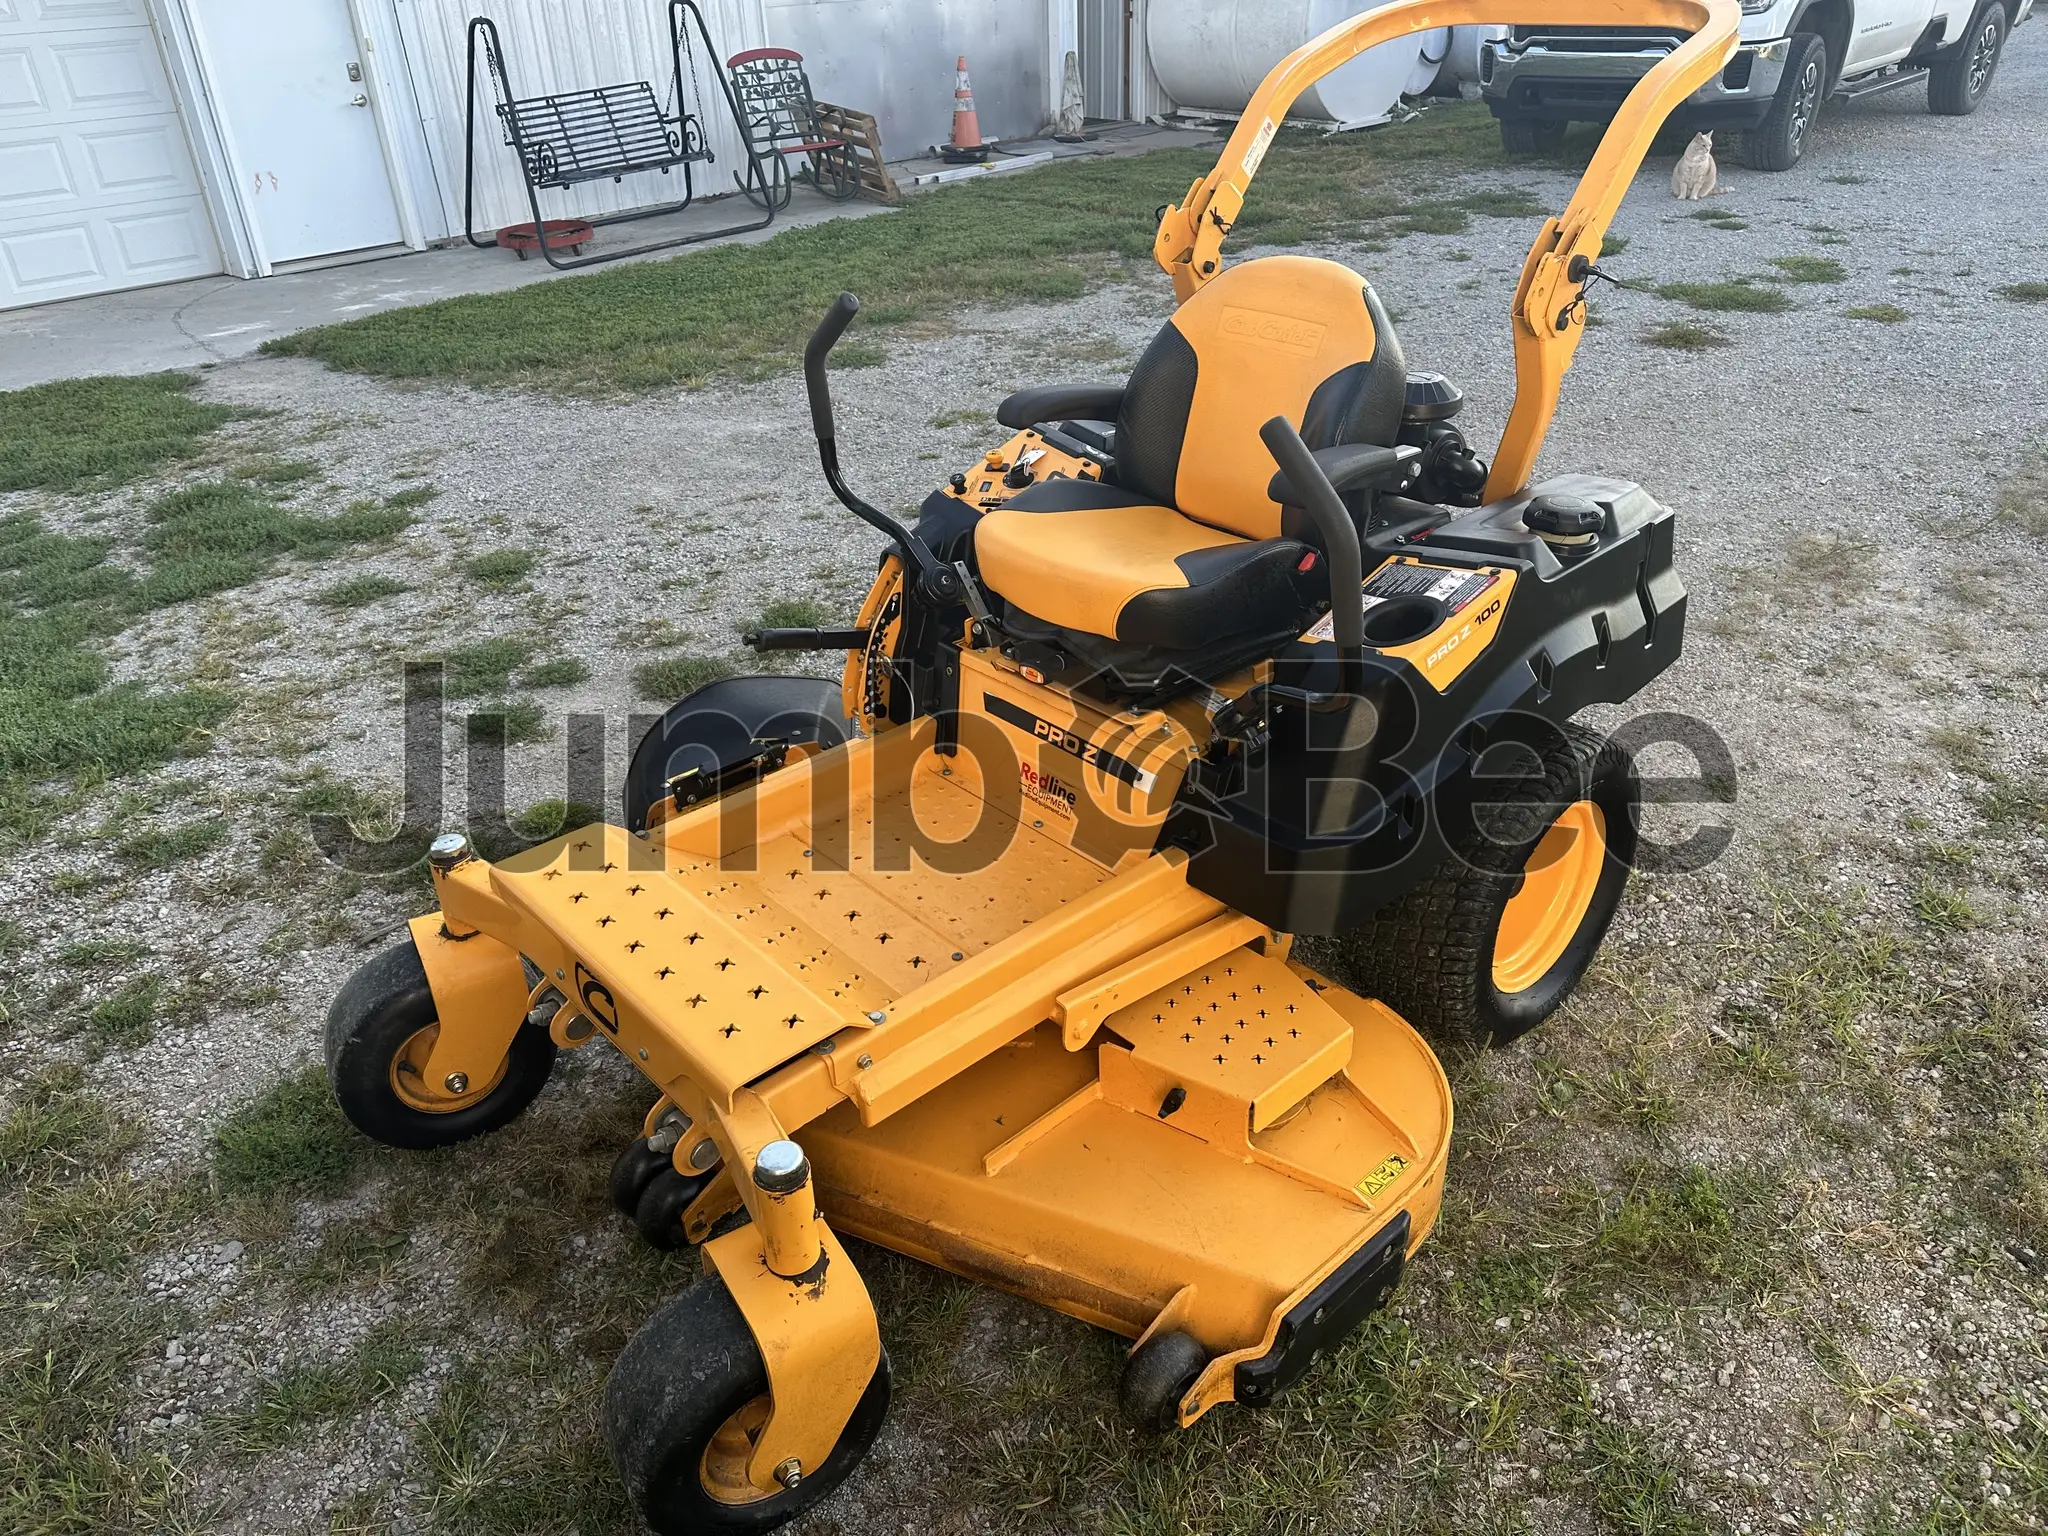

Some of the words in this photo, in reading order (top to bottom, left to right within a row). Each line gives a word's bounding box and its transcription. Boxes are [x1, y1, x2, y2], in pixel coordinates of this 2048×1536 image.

[1427, 634, 1460, 669] PRO
[1460, 624, 1472, 641] Z
[1474, 599, 1501, 626] 100
[1034, 719, 1080, 754] PRO
[1082, 743, 1098, 764] Z
[1020, 761, 1076, 805] Redline
[1026, 783, 1075, 815] EQUIPMENT
